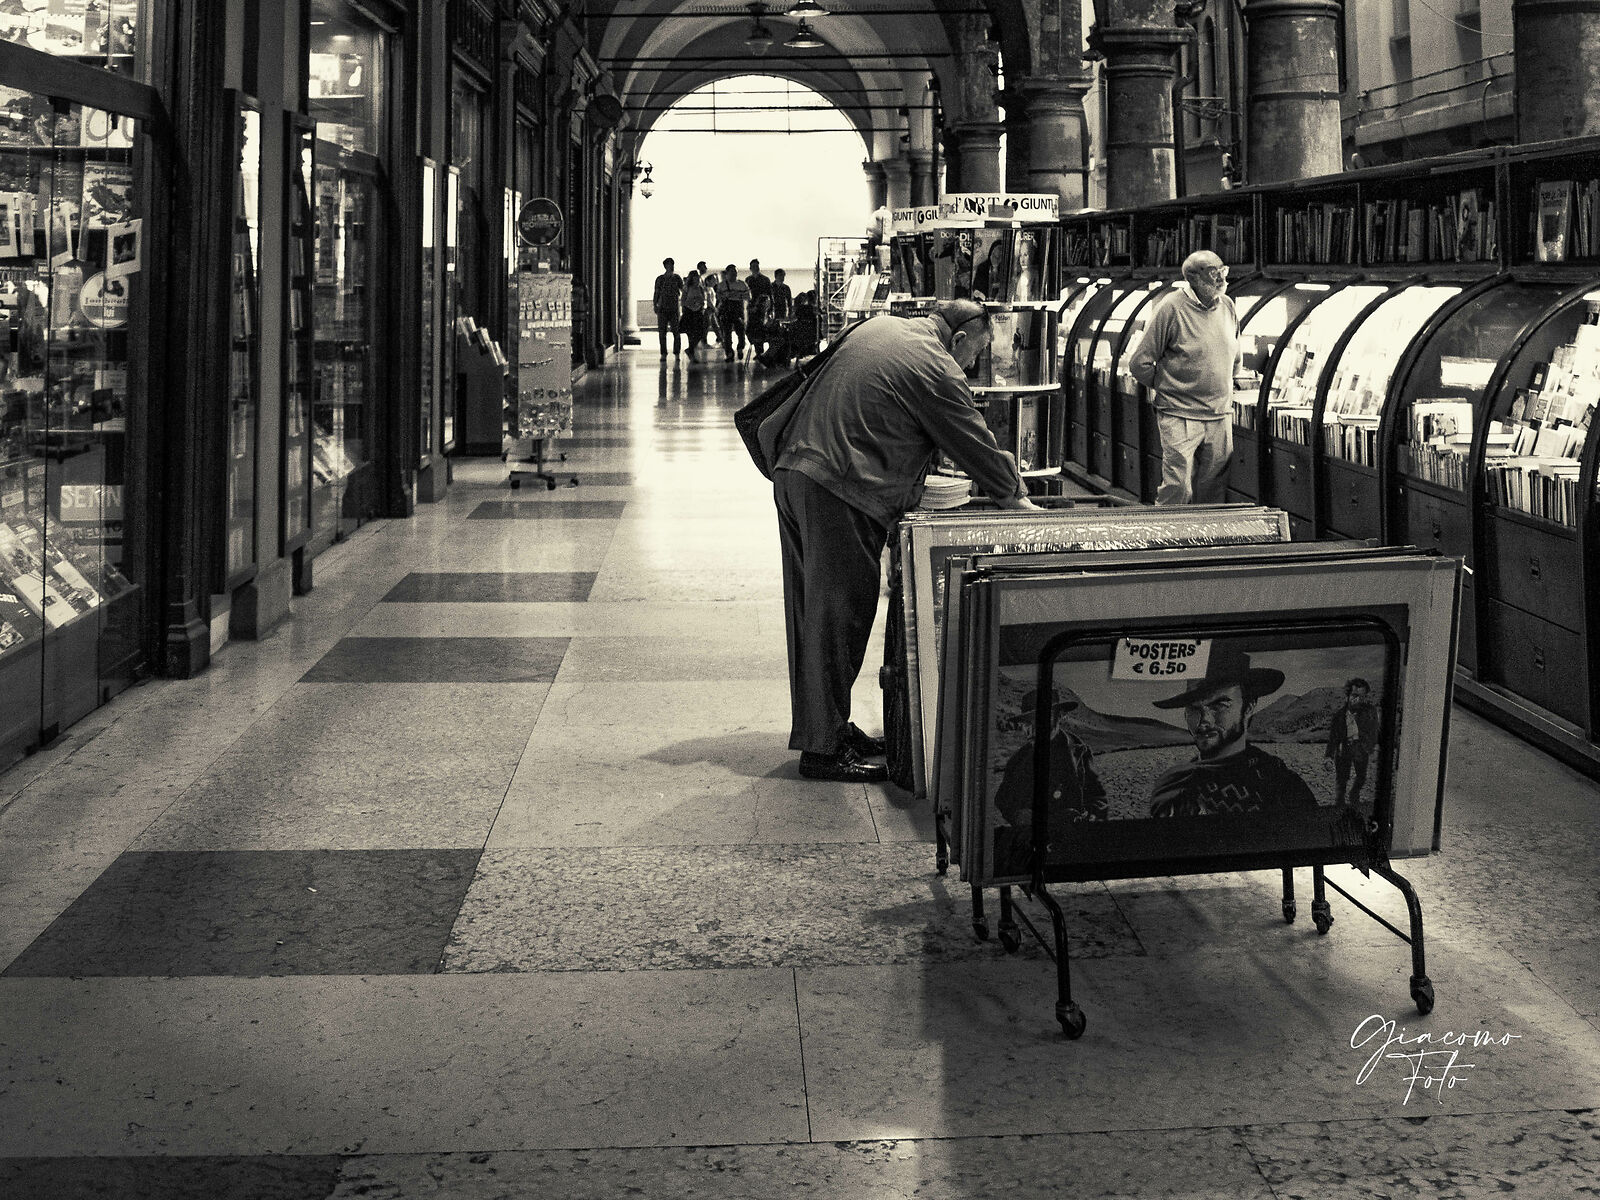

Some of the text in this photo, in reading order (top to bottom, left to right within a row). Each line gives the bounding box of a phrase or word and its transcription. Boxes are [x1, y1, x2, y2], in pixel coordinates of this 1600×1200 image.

[1129, 642, 1197, 660] POSTERS
[1132, 661, 1187, 675] € 6.50
